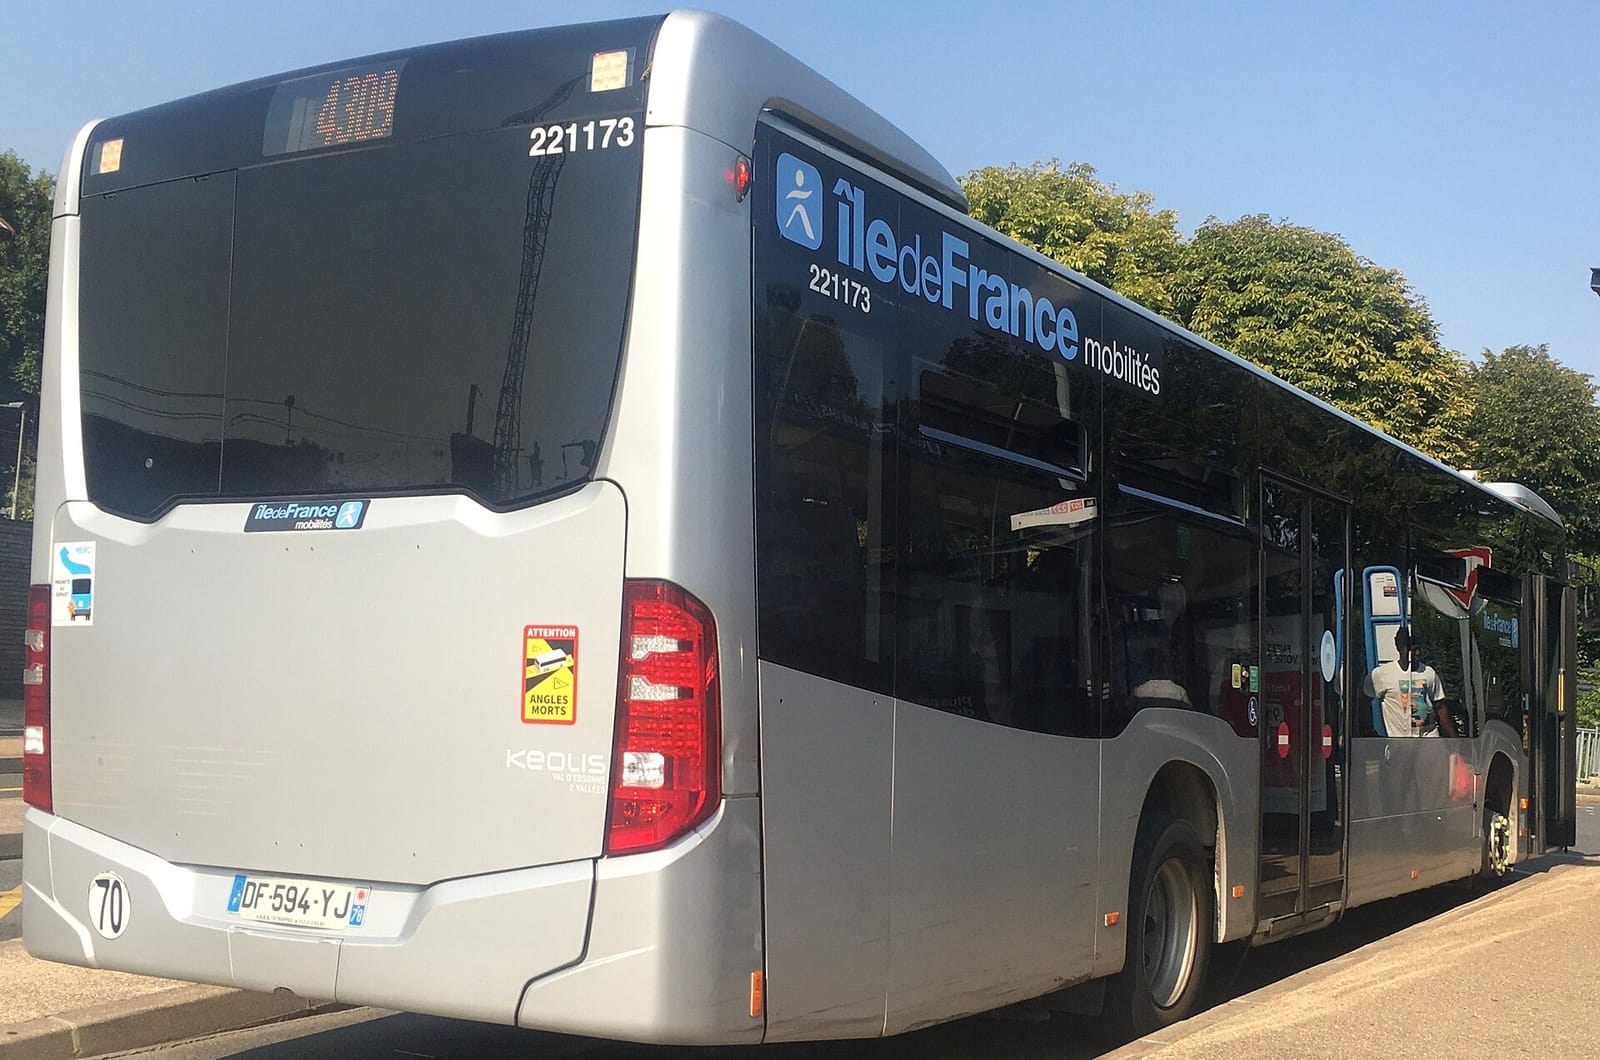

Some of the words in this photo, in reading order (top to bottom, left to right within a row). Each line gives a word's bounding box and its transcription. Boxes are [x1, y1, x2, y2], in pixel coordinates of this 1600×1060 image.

[316, 70, 398, 145] 4309
[528, 116, 635, 157] 221173
[808, 263, 872, 314] 221173
[1083, 335, 1161, 396] mobilités
[294, 518, 333, 530] mobilités
[527, 627, 576, 638] ATTENTION
[529, 694, 569, 705] ANGLES
[531, 705, 567, 716] MORTS
[95, 878, 123, 935] 70
[350, 907, 364, 923] 78
